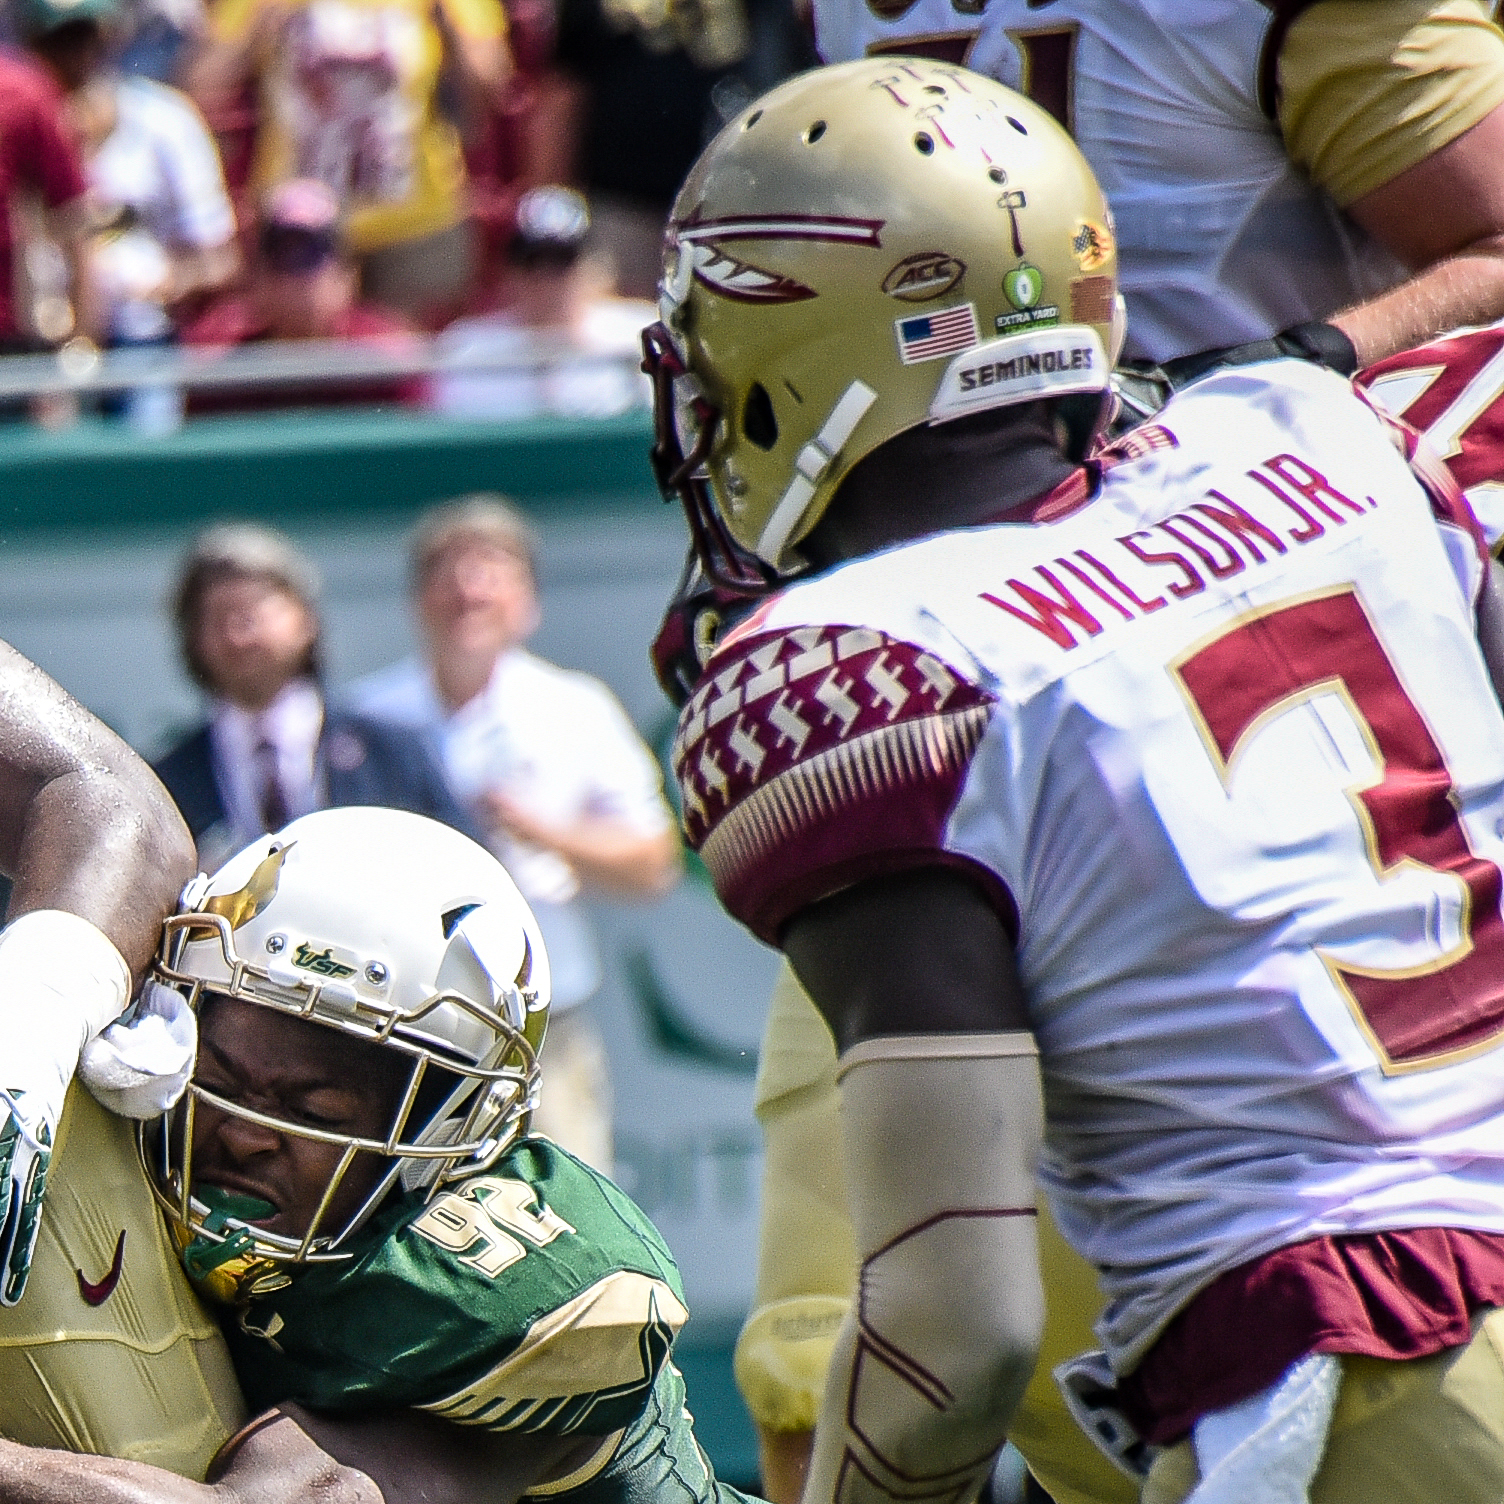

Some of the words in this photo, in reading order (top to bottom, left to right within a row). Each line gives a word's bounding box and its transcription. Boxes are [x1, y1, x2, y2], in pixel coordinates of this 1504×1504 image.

[959, 347, 1094, 392] SEMINOLES
[977, 488, 1288, 651] WILSON
[1215, 453, 1378, 545] JR.
[1166, 581, 1504, 1078] 3
